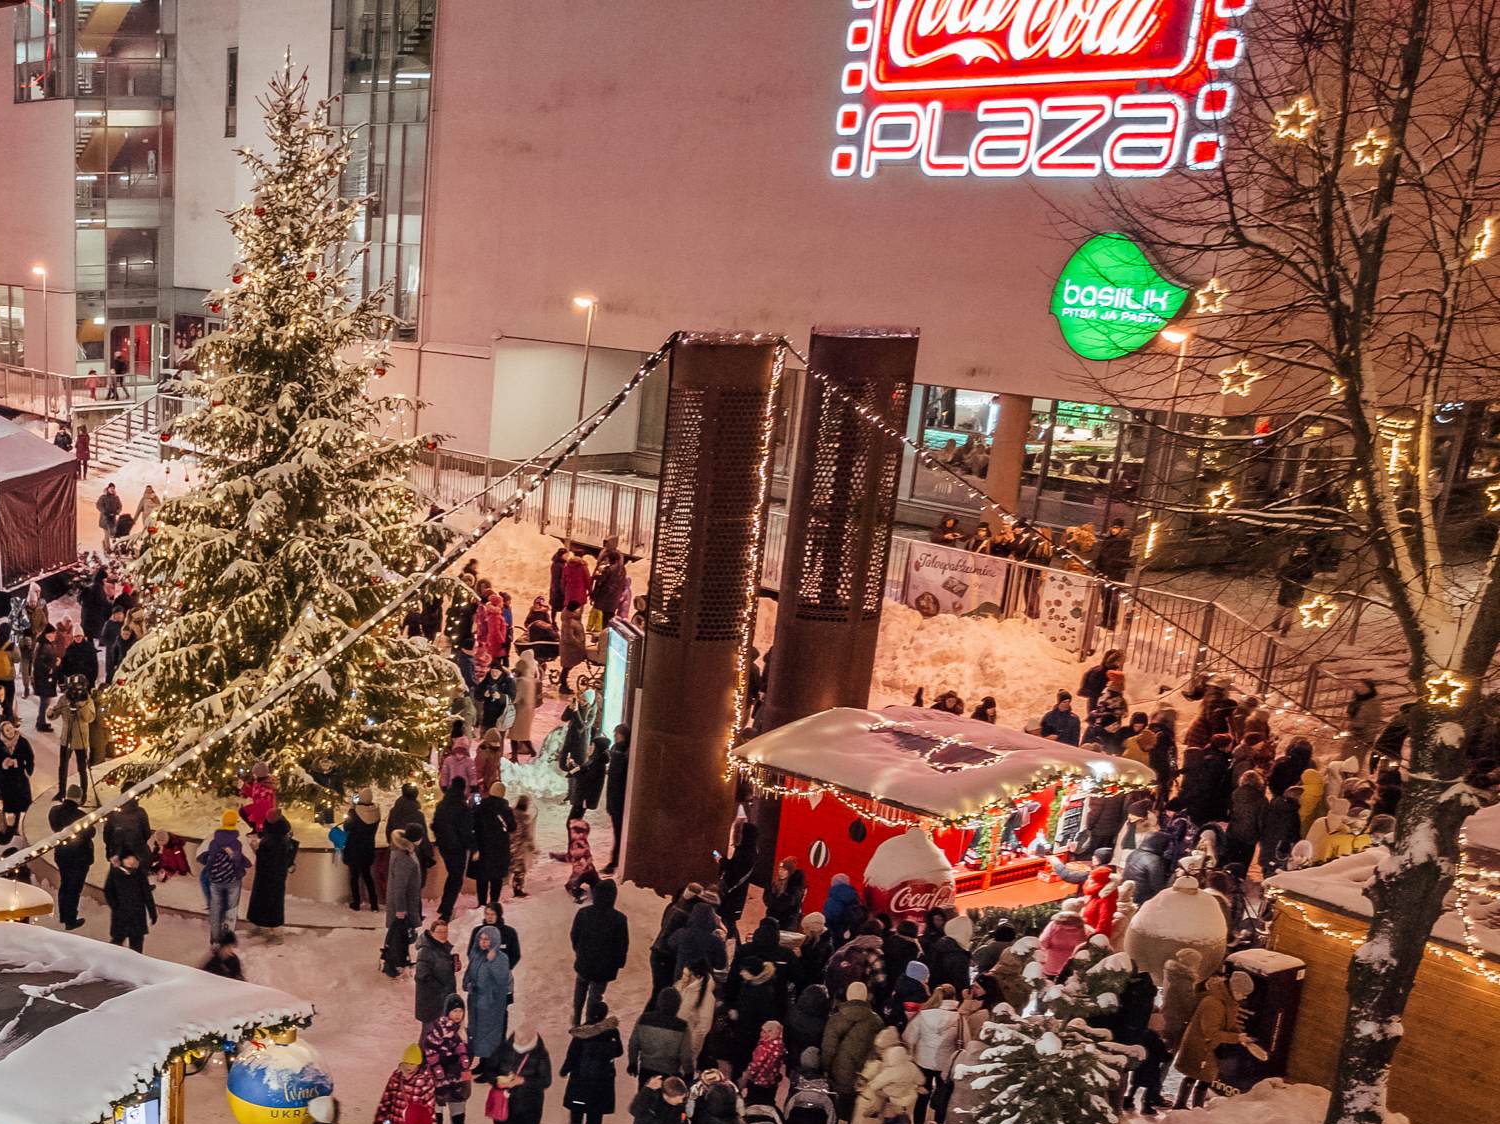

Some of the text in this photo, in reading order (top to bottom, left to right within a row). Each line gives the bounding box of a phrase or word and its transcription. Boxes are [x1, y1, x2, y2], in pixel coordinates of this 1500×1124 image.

[889, 0, 1160, 67] CocaCola
[1062, 307, 1097, 319] PITSA
[1100, 310, 1117, 321] JA
[1211, 1079, 1241, 1097] ringo
